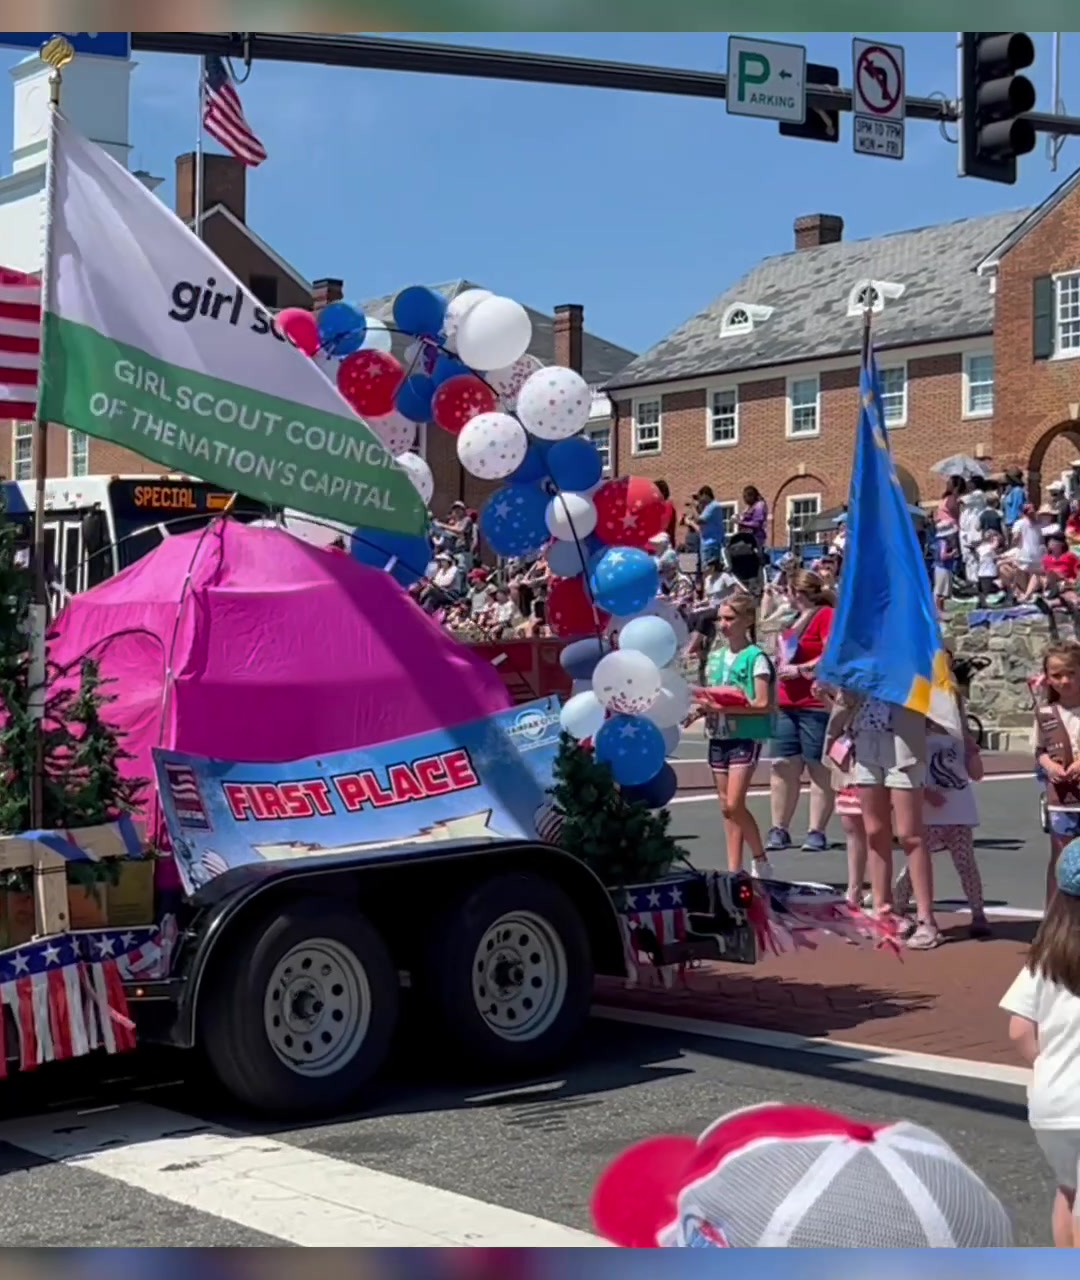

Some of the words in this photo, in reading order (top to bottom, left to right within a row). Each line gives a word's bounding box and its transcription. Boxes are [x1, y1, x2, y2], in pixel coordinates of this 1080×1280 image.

[168, 277, 244, 327] girl
[114, 360, 172, 402] GIRL
[175, 385, 283, 437] SCOUT
[89, 392, 128, 419] OF
[299, 469, 396, 512] CAPITAL
[134, 485, 197, 508] SPECIAL
[222, 777, 335, 821] FIRST
[330, 747, 481, 812] PLACE
